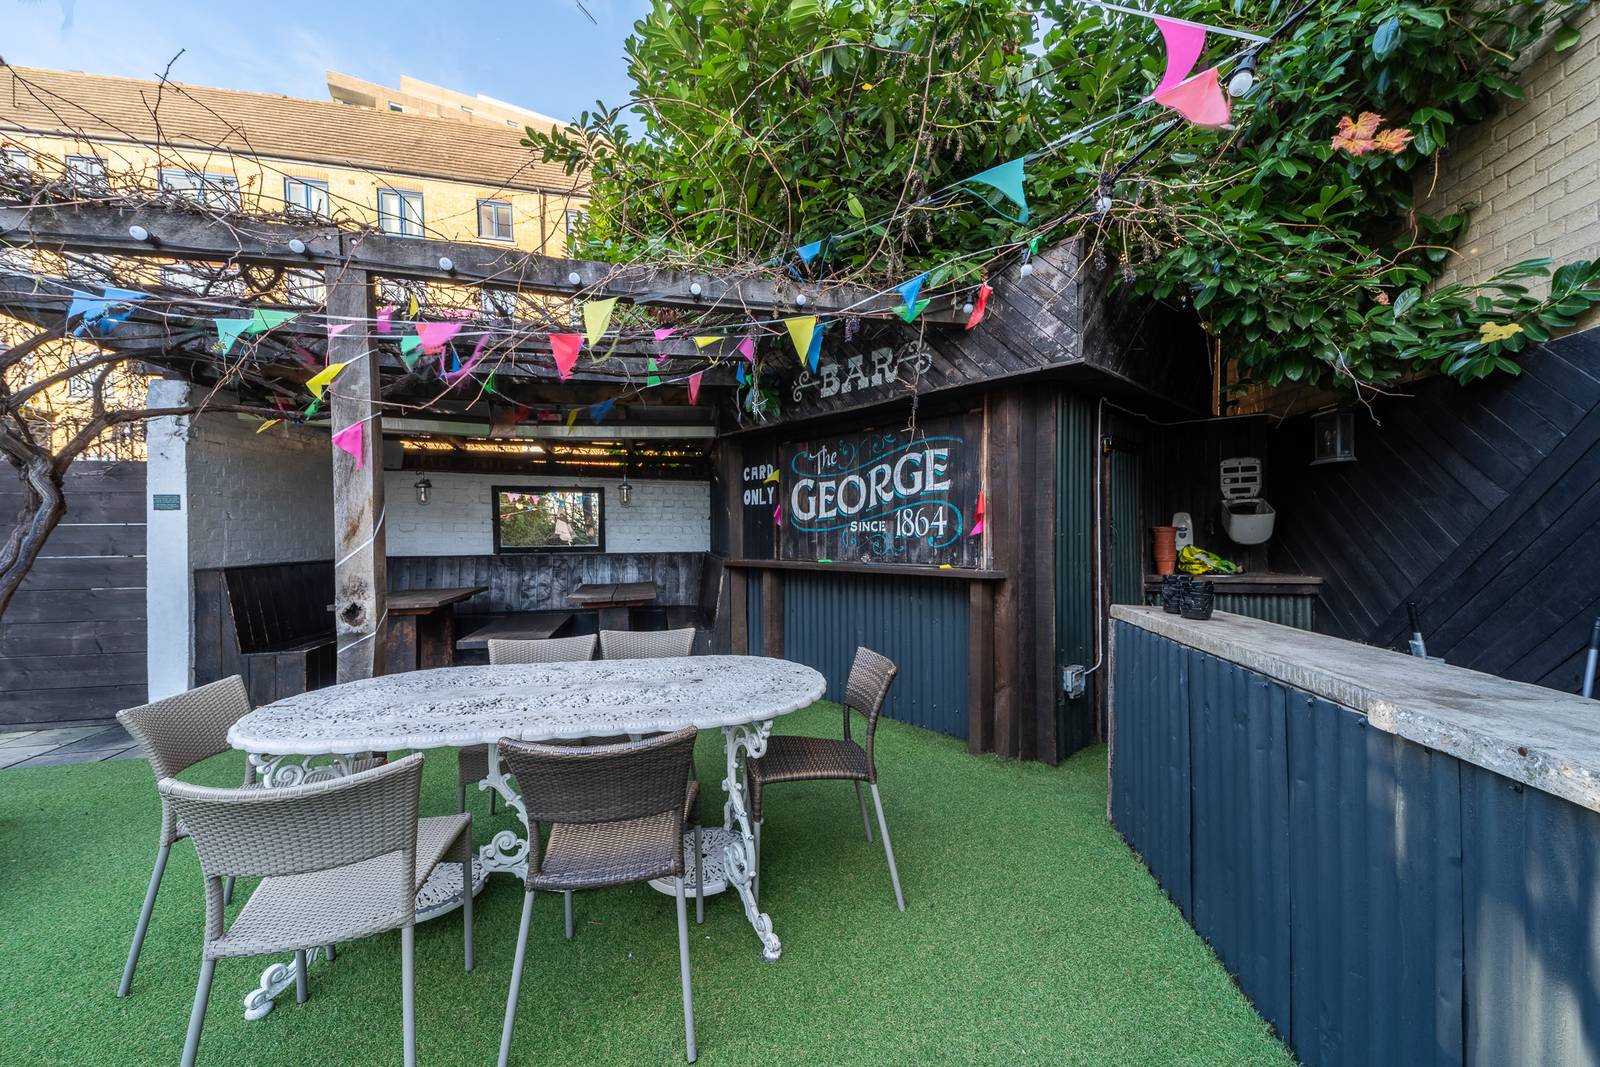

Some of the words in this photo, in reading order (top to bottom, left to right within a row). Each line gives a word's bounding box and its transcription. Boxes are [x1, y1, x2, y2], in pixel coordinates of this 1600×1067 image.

[820, 347, 898, 398] BAR
[743, 463, 774, 481] CARD
[809, 445, 838, 474] The
[743, 486, 775, 505] ONLY
[791, 448, 951, 522] GEORGE
[850, 521, 886, 532] SINCE
[896, 506, 947, 537] 1864
